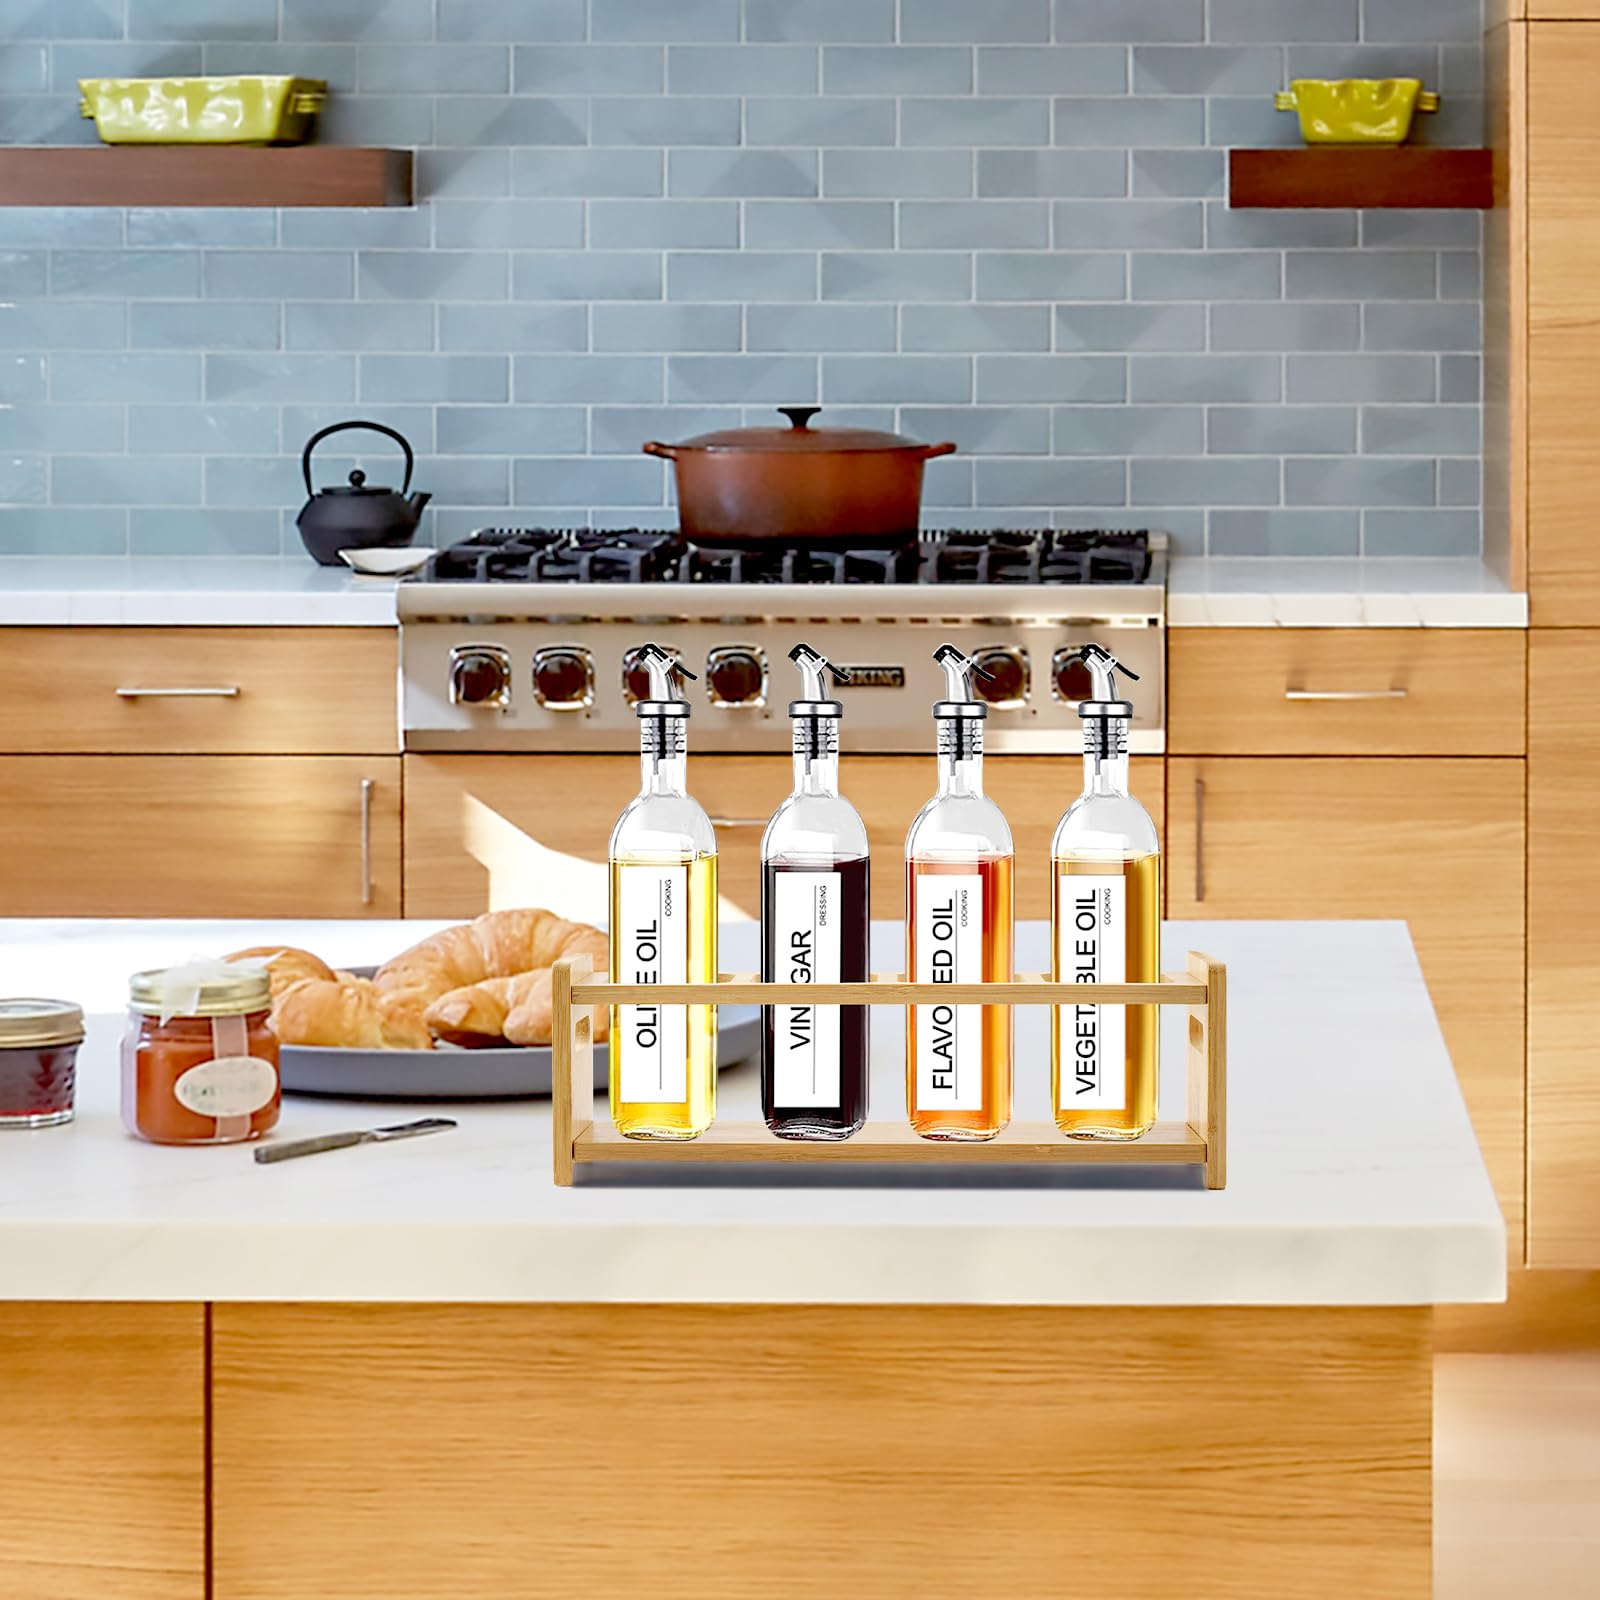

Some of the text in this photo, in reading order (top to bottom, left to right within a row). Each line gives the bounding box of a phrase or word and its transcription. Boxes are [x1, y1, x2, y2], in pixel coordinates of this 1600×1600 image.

[664, 879, 672, 917] COOKING
[819, 885, 827, 926] DRESSING
[960, 889, 968, 927] COOKING
[1103, 887, 1112, 925] COOKING
[635, 919, 658, 1049] OLIE OIL
[790, 929, 812, 1051] VINGAR
[932, 898, 953, 1089] FLAVOED OIL
[1075, 888, 1096, 1096] VEGETBLE OIL
